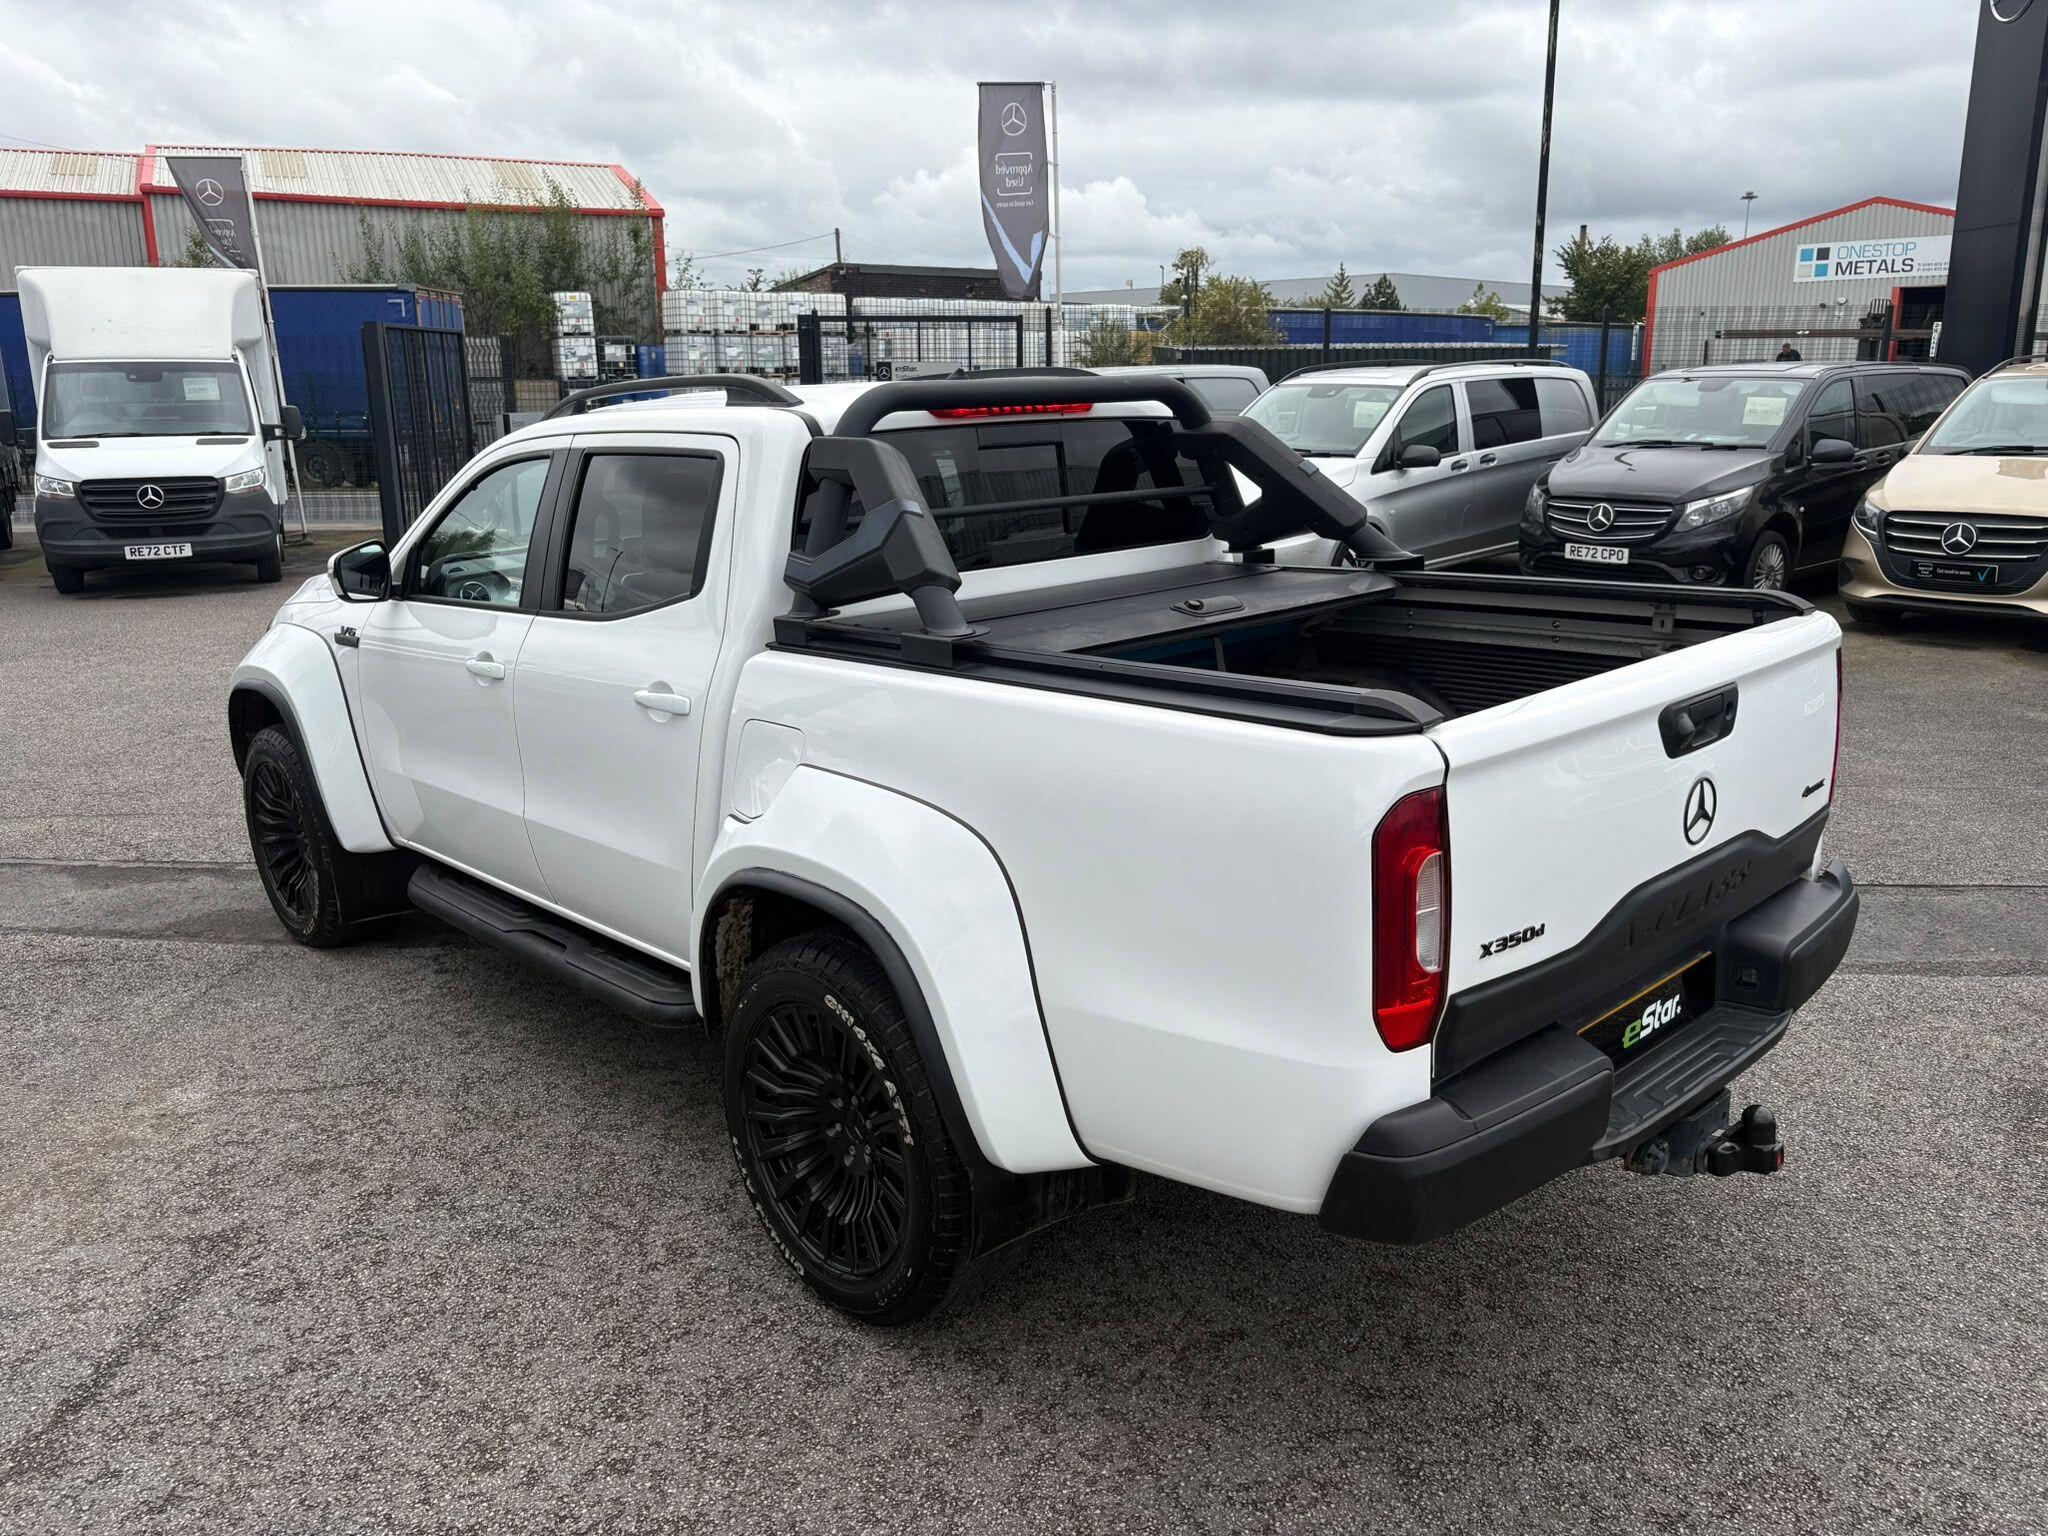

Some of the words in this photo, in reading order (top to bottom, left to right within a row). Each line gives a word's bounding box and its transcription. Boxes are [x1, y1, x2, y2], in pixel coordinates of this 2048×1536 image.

[1837, 241, 1917, 260] ONESTOP
[1835, 257, 1915, 276] METALS
[129, 546, 161, 558] RE72
[163, 544, 187, 556] CTF
[1569, 545, 1598, 559] RE72
[1601, 548, 1625, 561] CPO
[340, 625, 357, 637] V6
[1479, 922, 1546, 960] X350d
